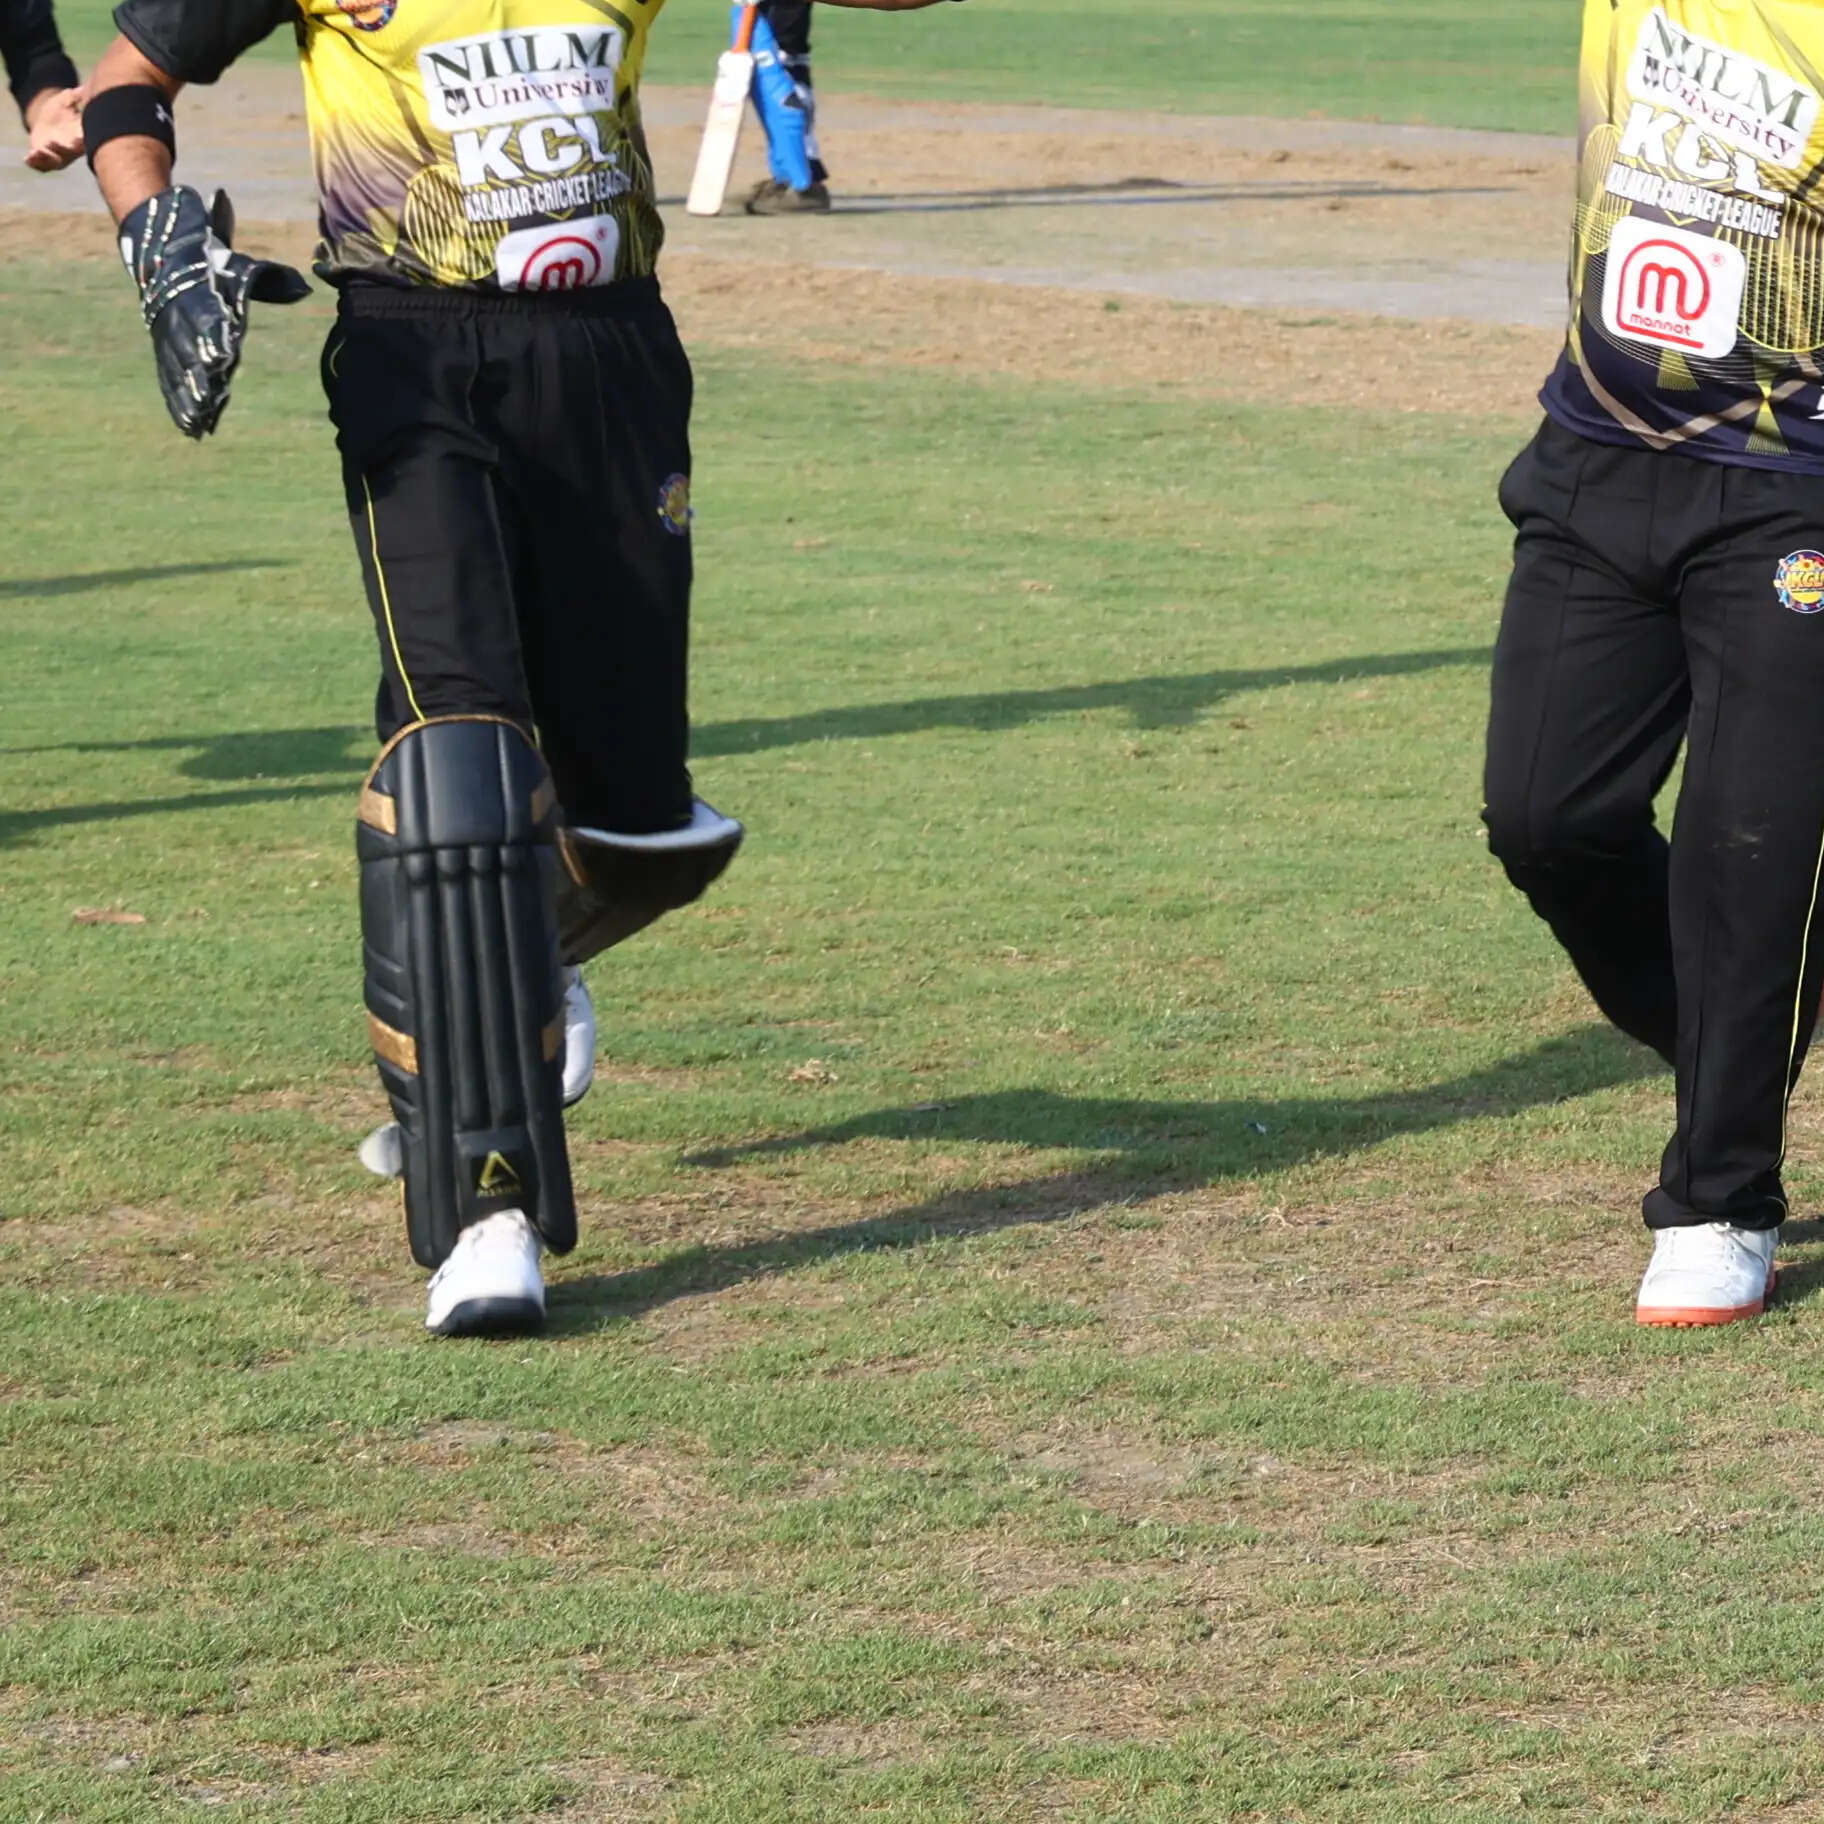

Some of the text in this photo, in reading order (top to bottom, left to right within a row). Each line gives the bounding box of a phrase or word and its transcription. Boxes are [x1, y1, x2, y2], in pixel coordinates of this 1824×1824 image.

[422, 32, 617, 87] NIILM
[453, 115, 617, 186] KCL
[1618, 101, 1785, 204] KCL
[533, 174, 591, 213] CRICKET
[1723, 196, 1783, 240] LEAGUE
[1629, 313, 1692, 337] mannat
